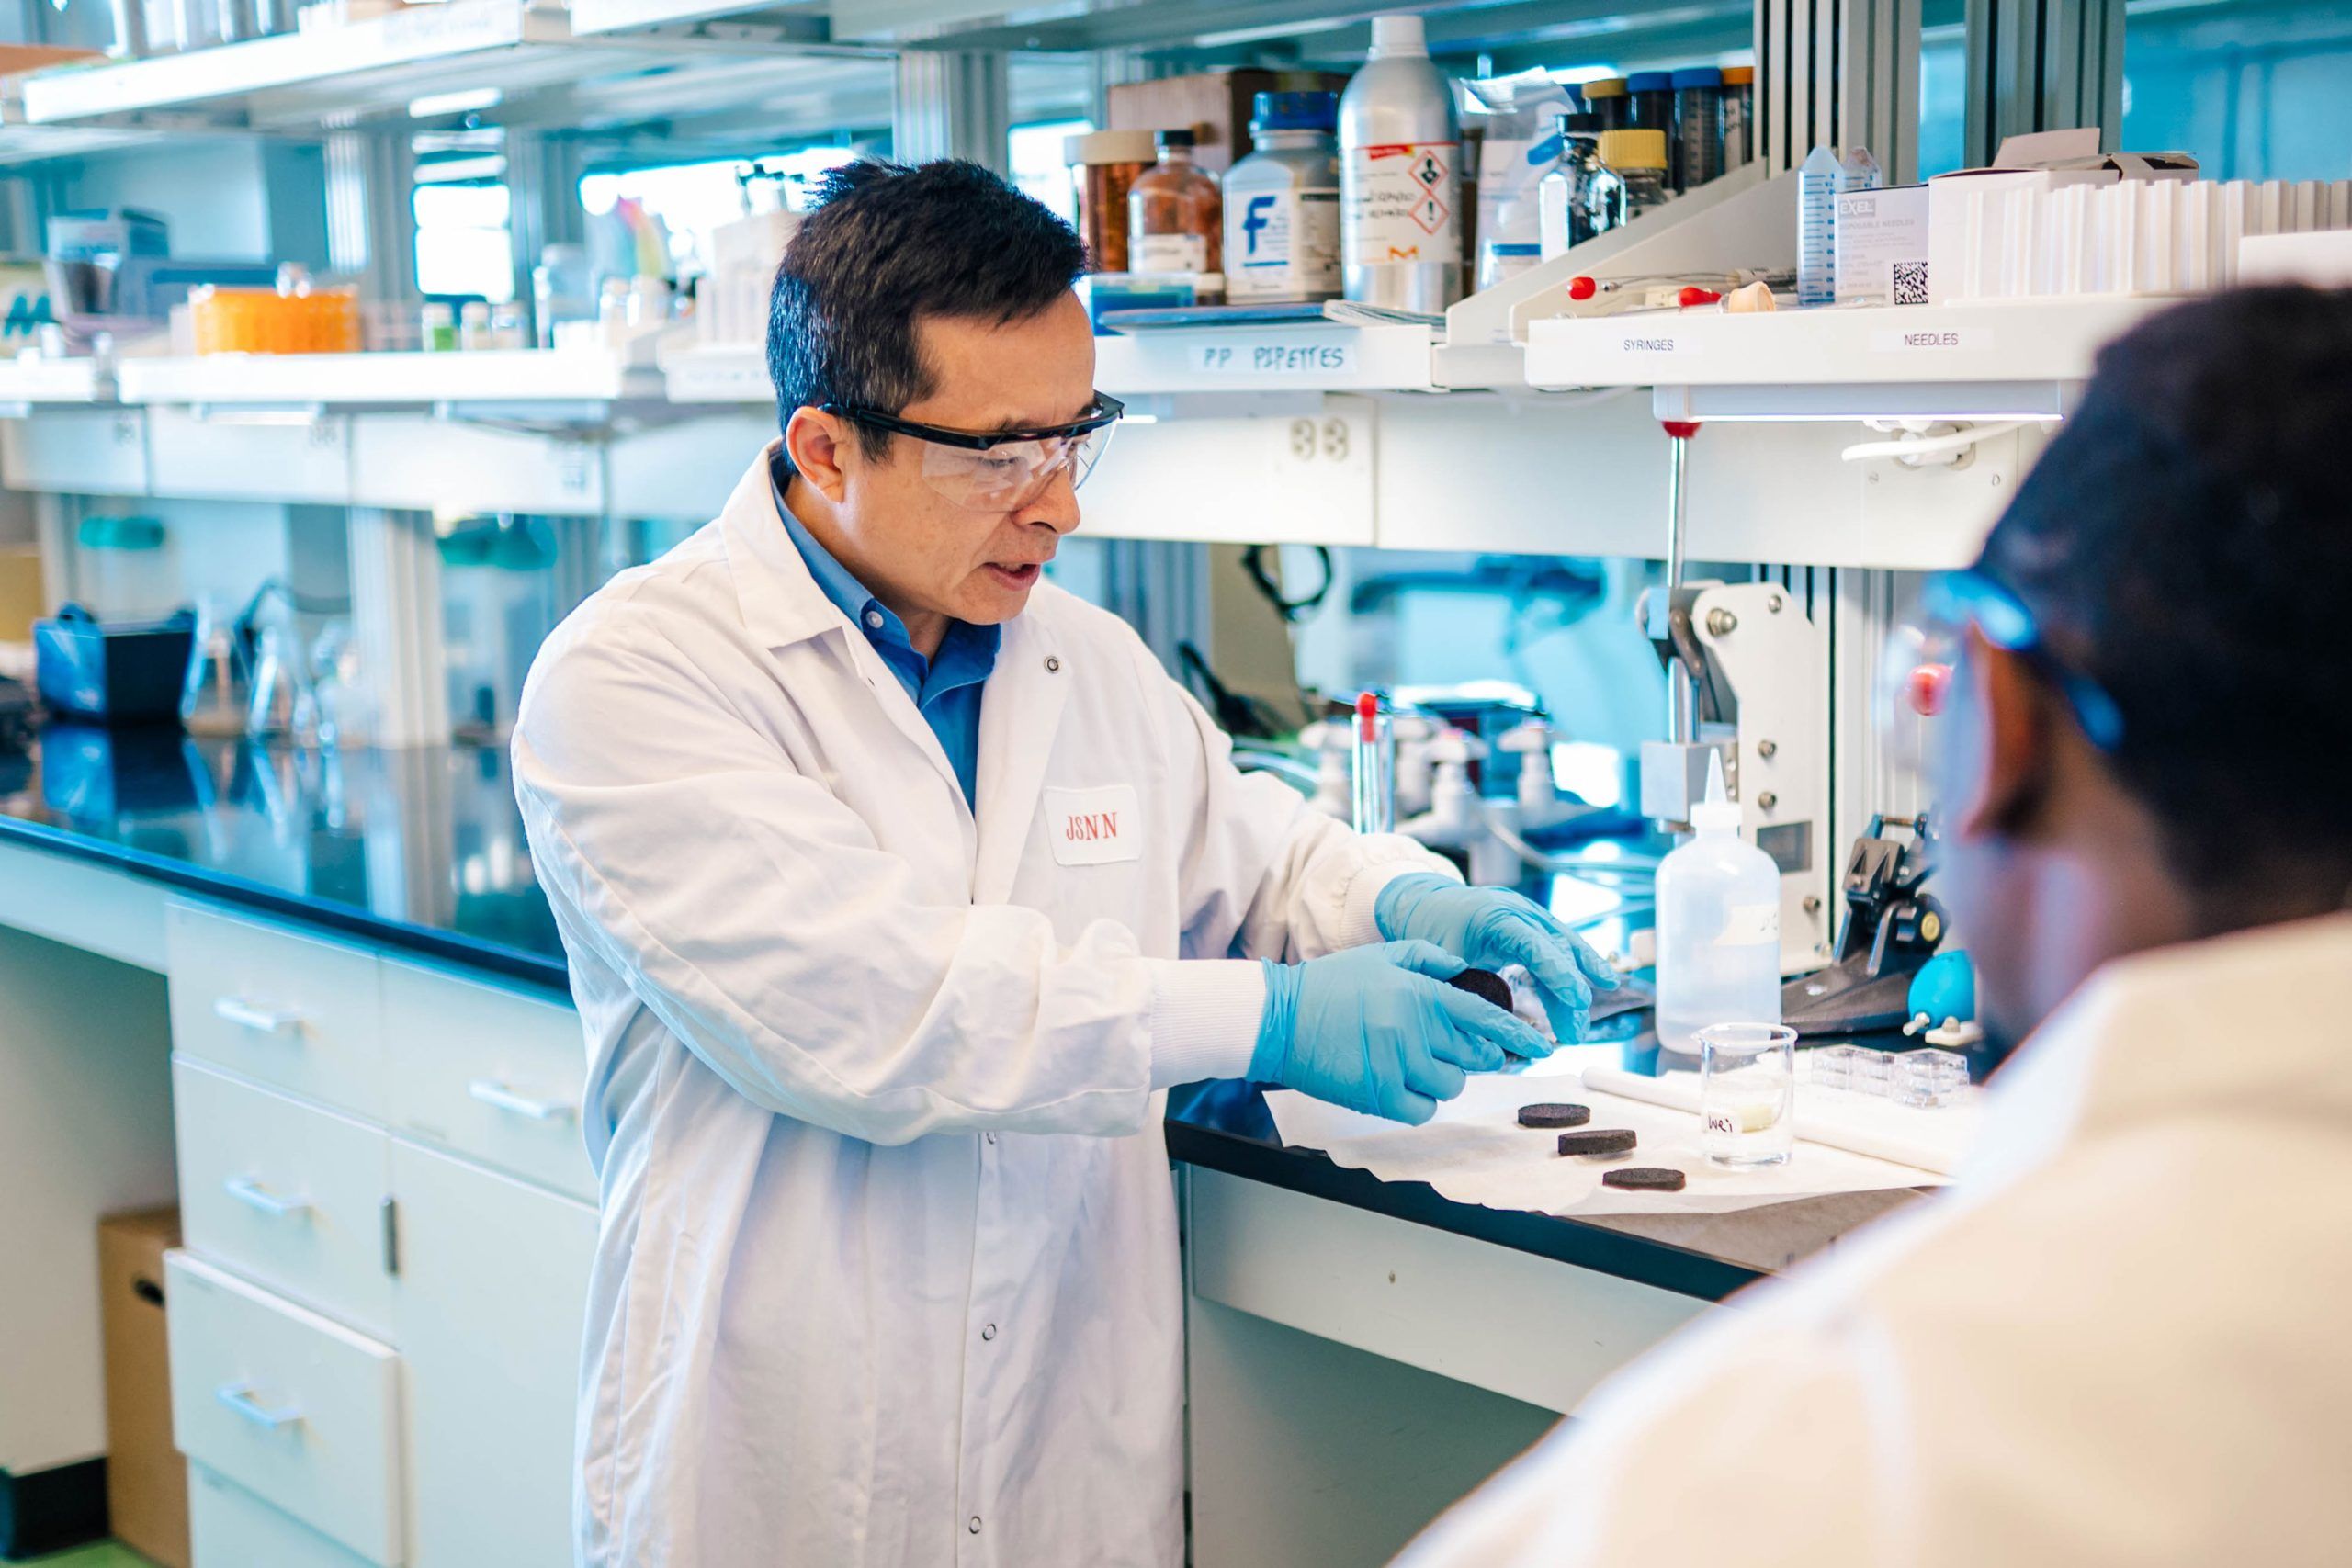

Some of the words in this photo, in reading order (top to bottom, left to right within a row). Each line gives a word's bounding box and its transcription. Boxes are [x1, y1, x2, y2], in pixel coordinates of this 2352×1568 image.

[1623, 339, 1674, 351] SYRINGES
[1905, 333, 1959, 346] NEEDLES
[1204, 347, 1232, 368] PP
[1254, 345, 1344, 369] PIPETTES
[1066, 812, 1117, 840] JSNN
